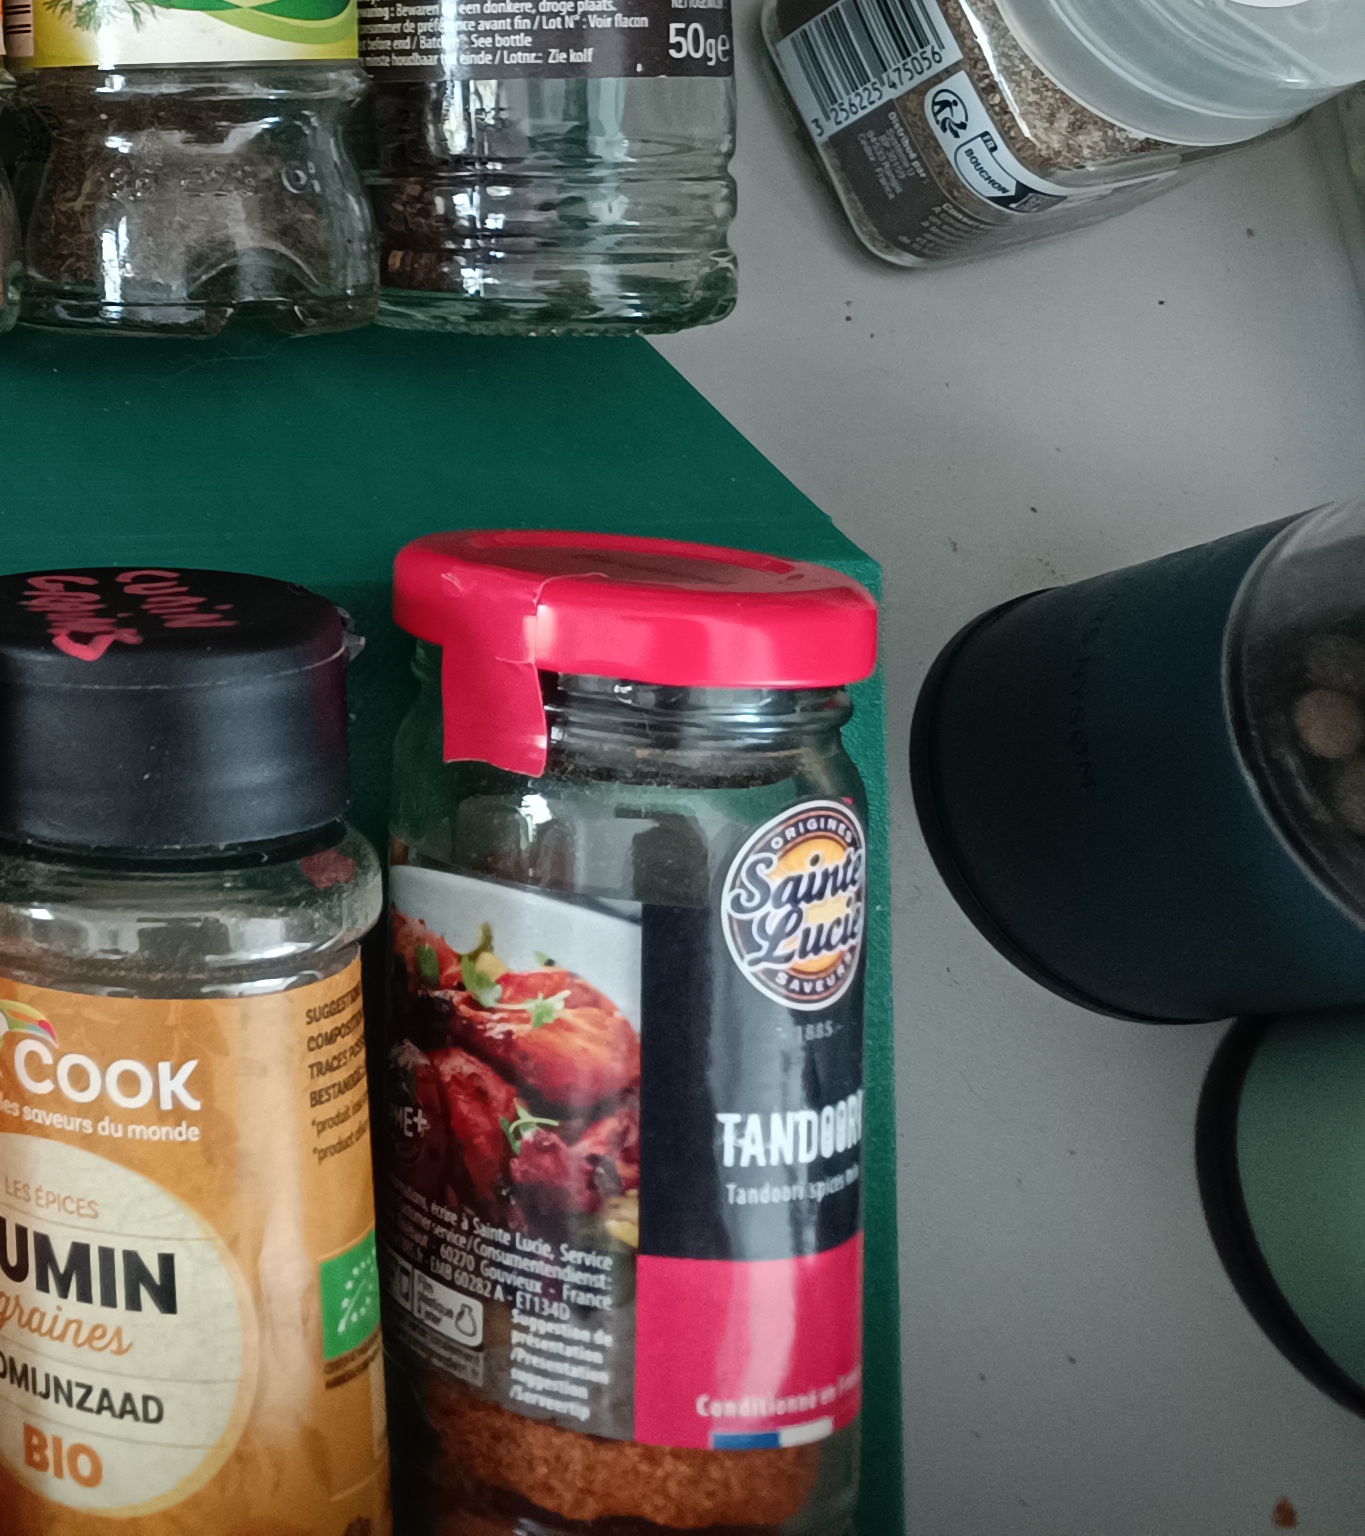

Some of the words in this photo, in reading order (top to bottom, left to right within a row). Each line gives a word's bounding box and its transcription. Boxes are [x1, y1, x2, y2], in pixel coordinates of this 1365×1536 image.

[829, 85, 884, 126] 256225
[886, 44, 944, 90] 475056
[964, 147, 1010, 194] BOUCHON
[13, 1038, 202, 1112] COOK
[21, 1105, 94, 1134] saveurs
[97, 1116, 124, 1138] du
[126, 1119, 201, 1143] monde
[3, 1174, 34, 1203] LES
[34, 1182, 100, 1220] ÉPICES
[561, 1242, 613, 1271] Service
[562, 1284, 613, 1310] France
[22, 1422, 104, 1489] BIO
